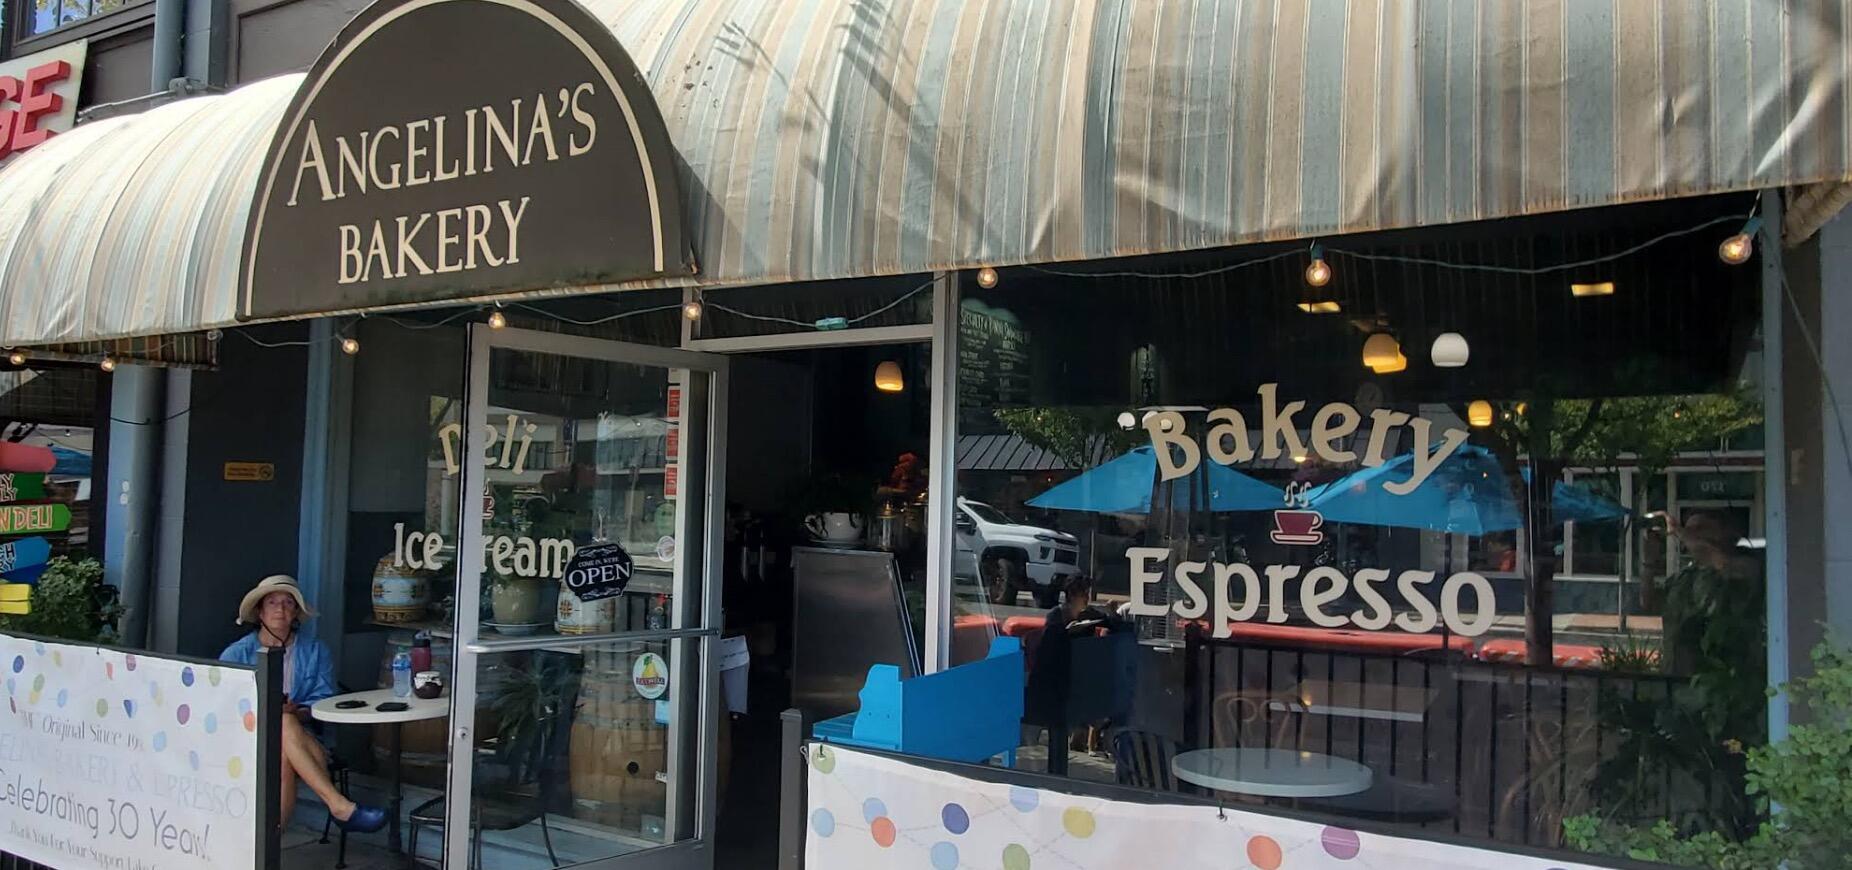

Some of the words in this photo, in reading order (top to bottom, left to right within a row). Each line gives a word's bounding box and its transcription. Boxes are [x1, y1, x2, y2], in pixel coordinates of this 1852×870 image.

[287, 82, 597, 207] ANGELINA'S
[338, 197, 531, 284] BAKERY
[1142, 382, 1470, 495] Bakery
[13, 504, 53, 531] DELI
[394, 522, 444, 571] Ice
[481, 535, 576, 580] ream
[568, 561, 630, 588] OPEN
[1125, 546, 1496, 638] Espresso
[107, 798, 140, 840] 30
